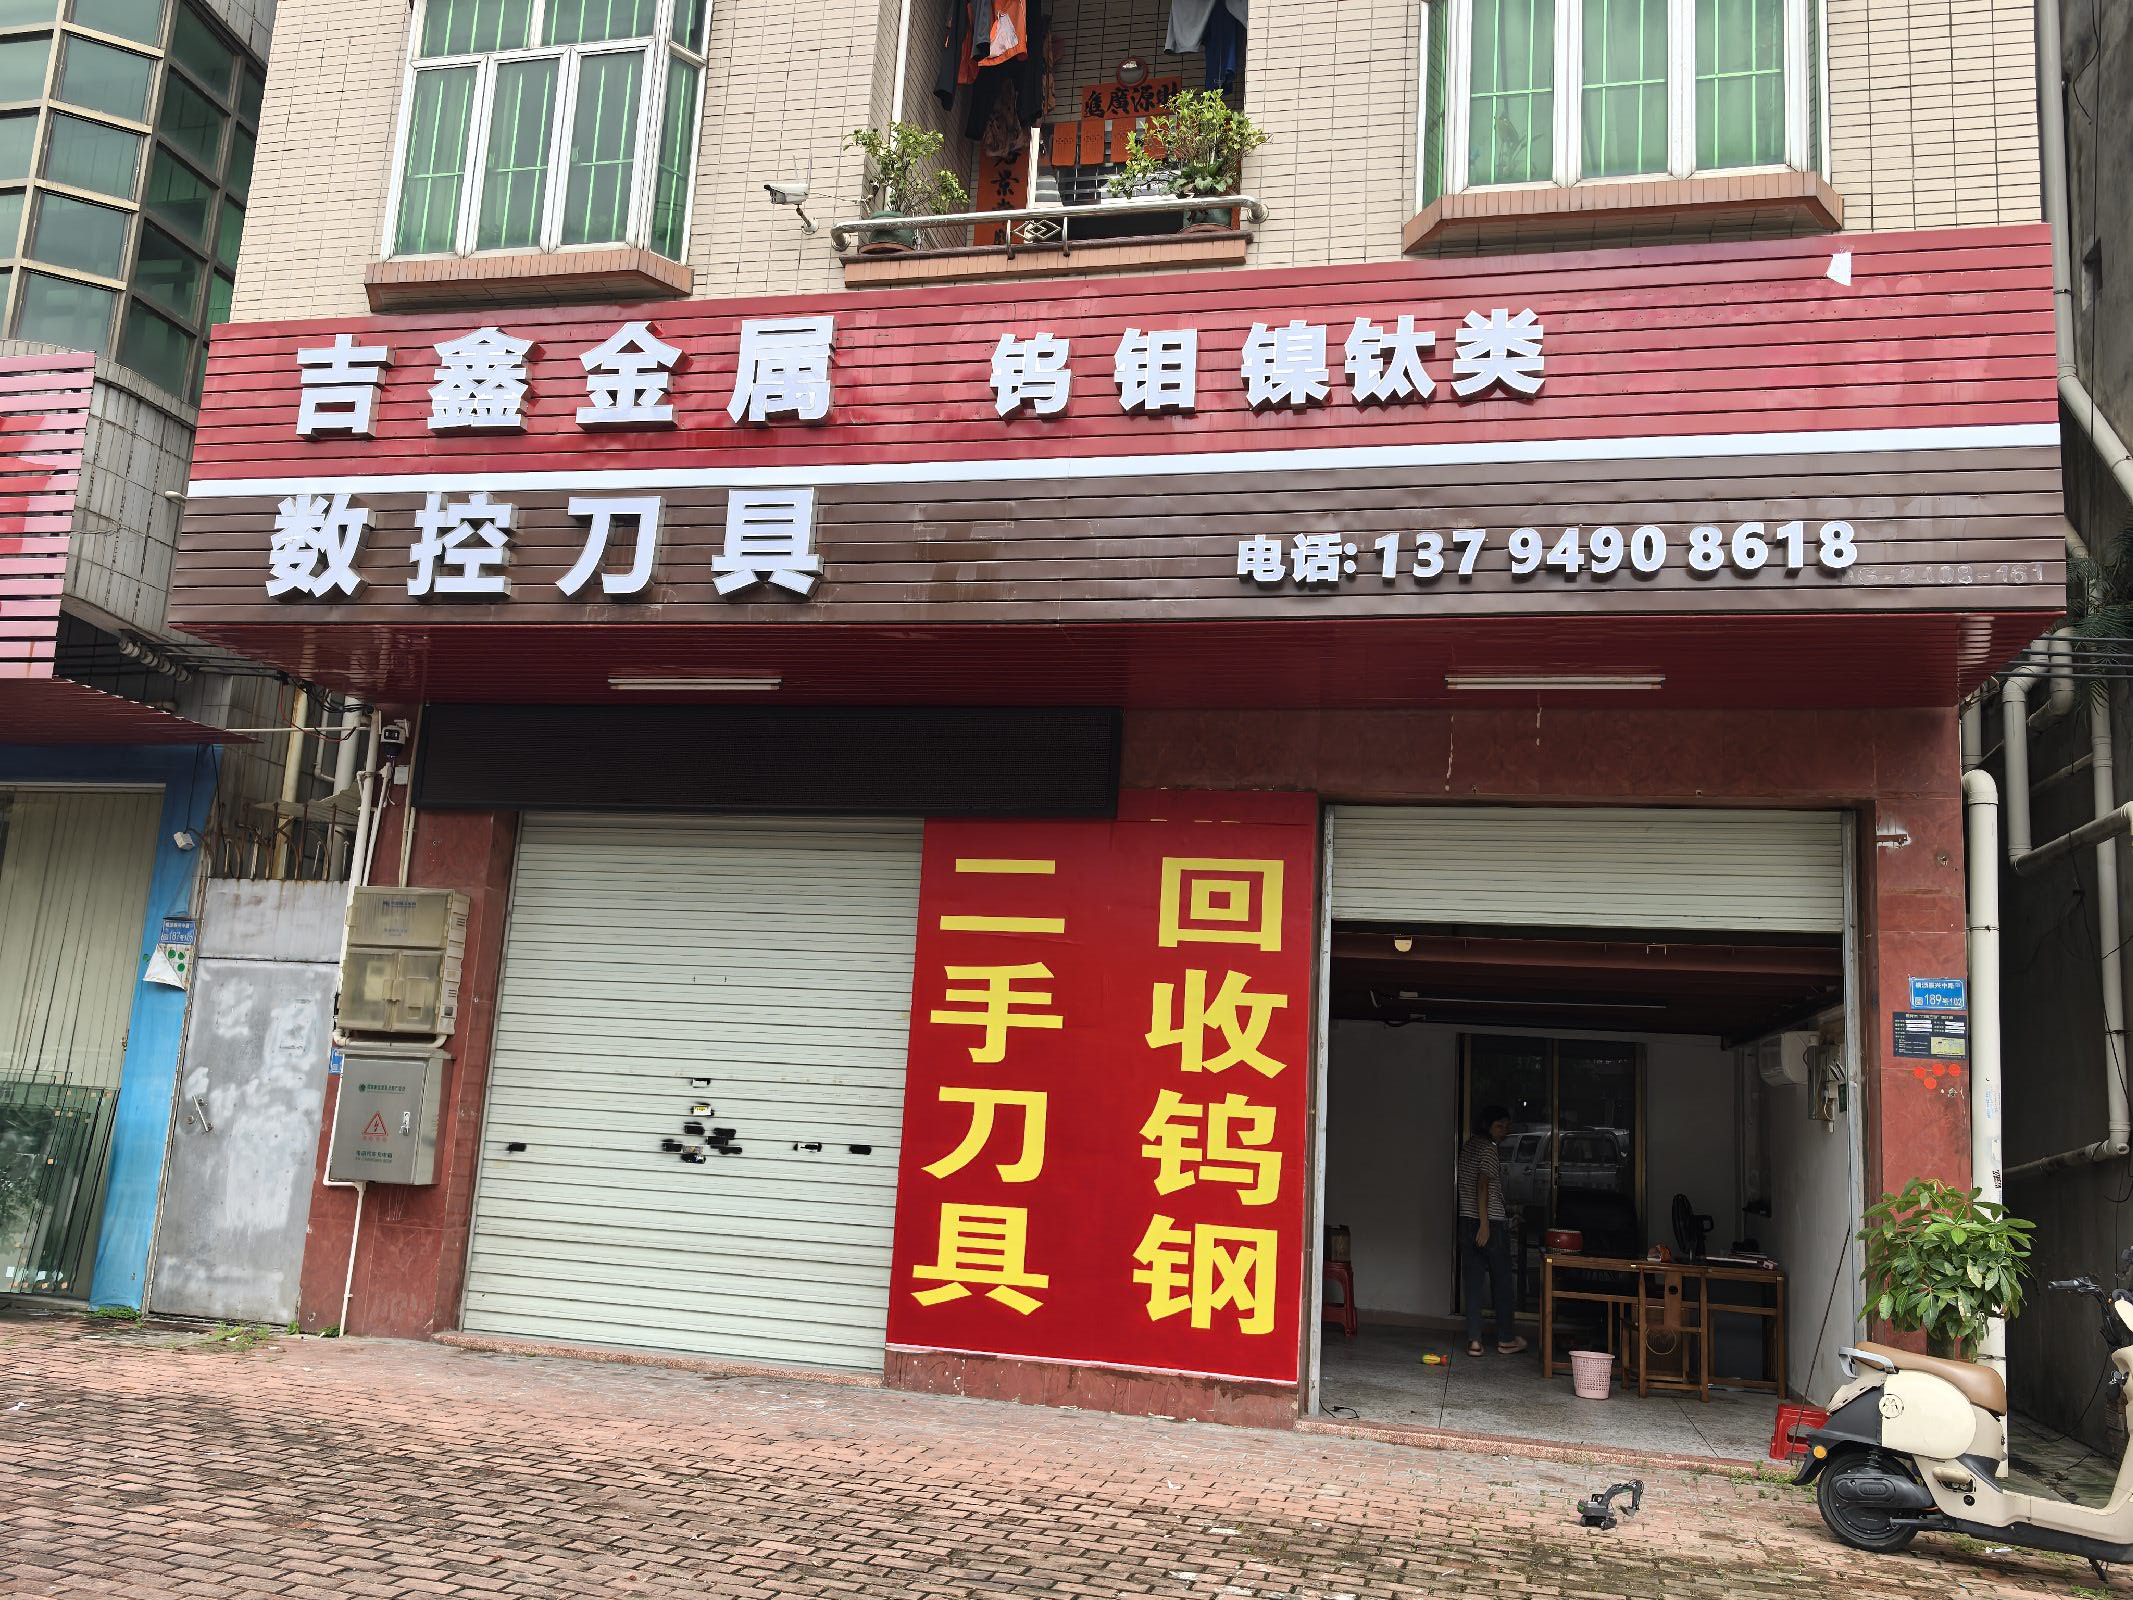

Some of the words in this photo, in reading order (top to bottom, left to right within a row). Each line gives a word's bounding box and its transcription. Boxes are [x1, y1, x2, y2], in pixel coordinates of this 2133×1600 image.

[296, 316, 835, 437] 吉鑫金属
[990, 308, 1545, 418] 钨钼镍钛类
[265, 487, 823, 598] 数控刀具
[1374, 530, 1488, 579] 137
[1508, 526, 1666, 575] 9490
[1688, 521, 1858, 571] 8618
[911, 858, 1066, 1316] 二手刀具
[1132, 857, 1289, 1336] 回收钨钢
